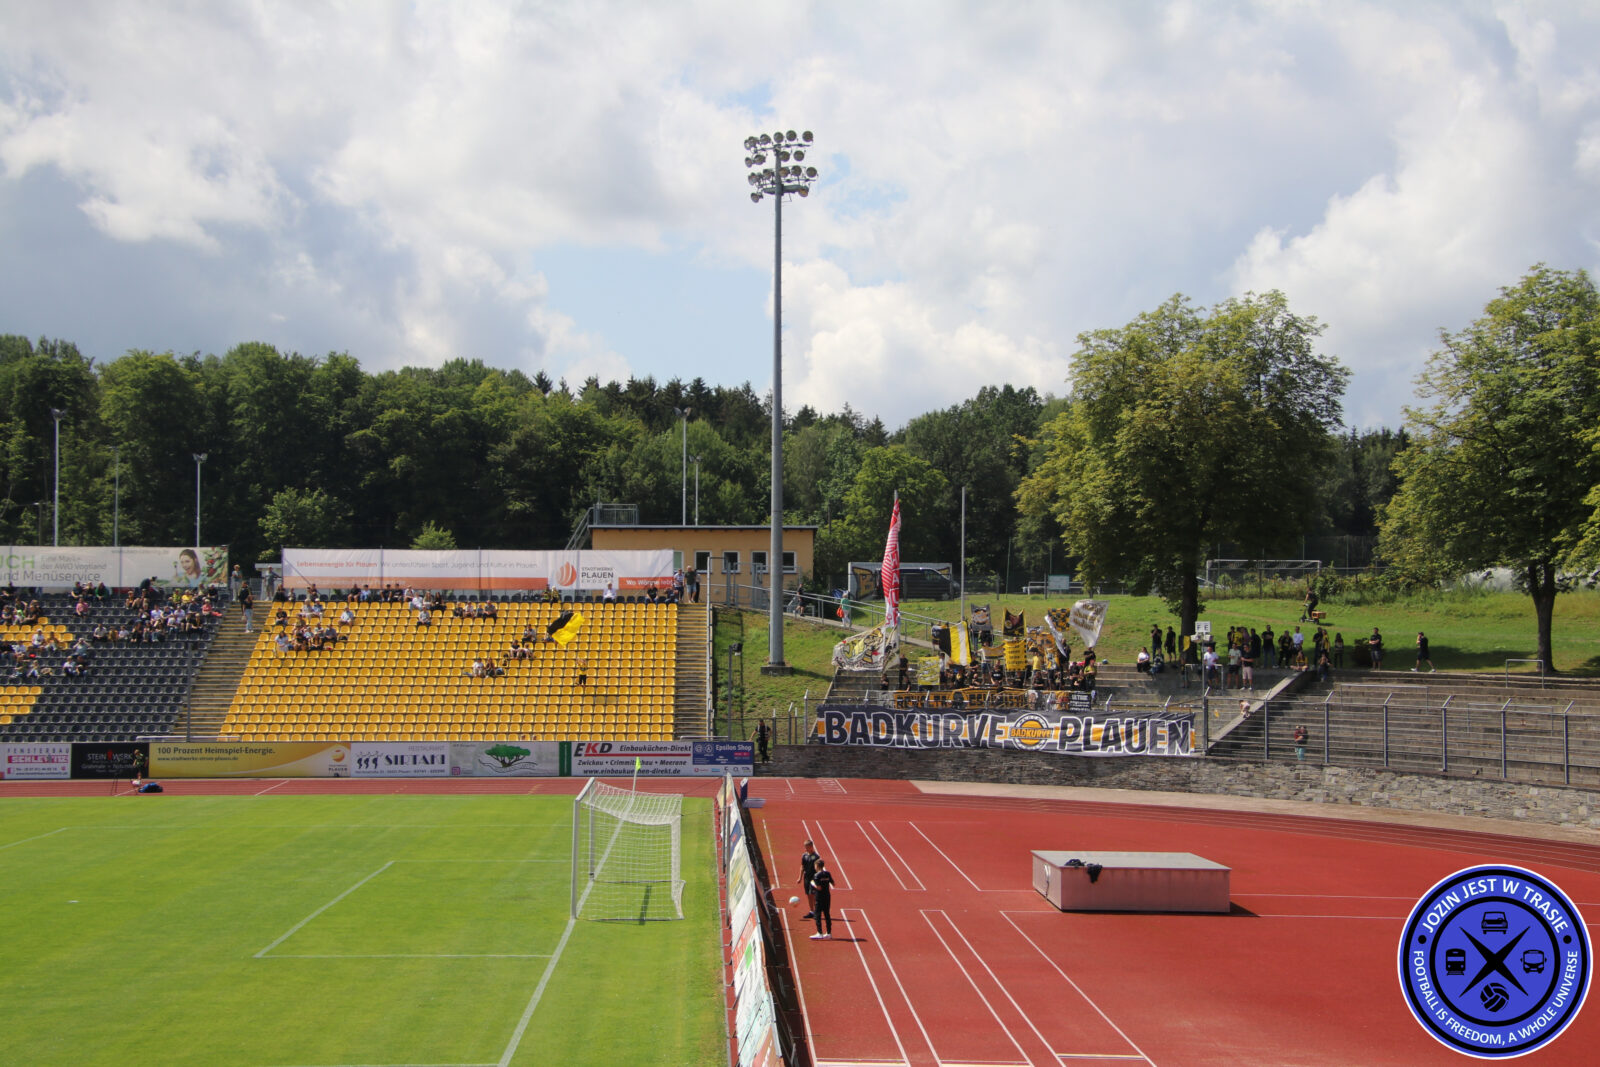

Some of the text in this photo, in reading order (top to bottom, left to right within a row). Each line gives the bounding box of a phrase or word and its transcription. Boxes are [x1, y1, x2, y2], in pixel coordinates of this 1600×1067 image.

[24, 570, 101, 581] Menüservice
[824, 711, 1191, 756] BADKURVE PLAUEN
[1010, 728, 1053, 738] BADKURVE
[204, 747, 276, 756] Heimspiel-Energie.
[574, 743, 613, 757] EKD
[737, 744, 752, 752] Shop
[384, 754, 446, 765] SIRTAKI
